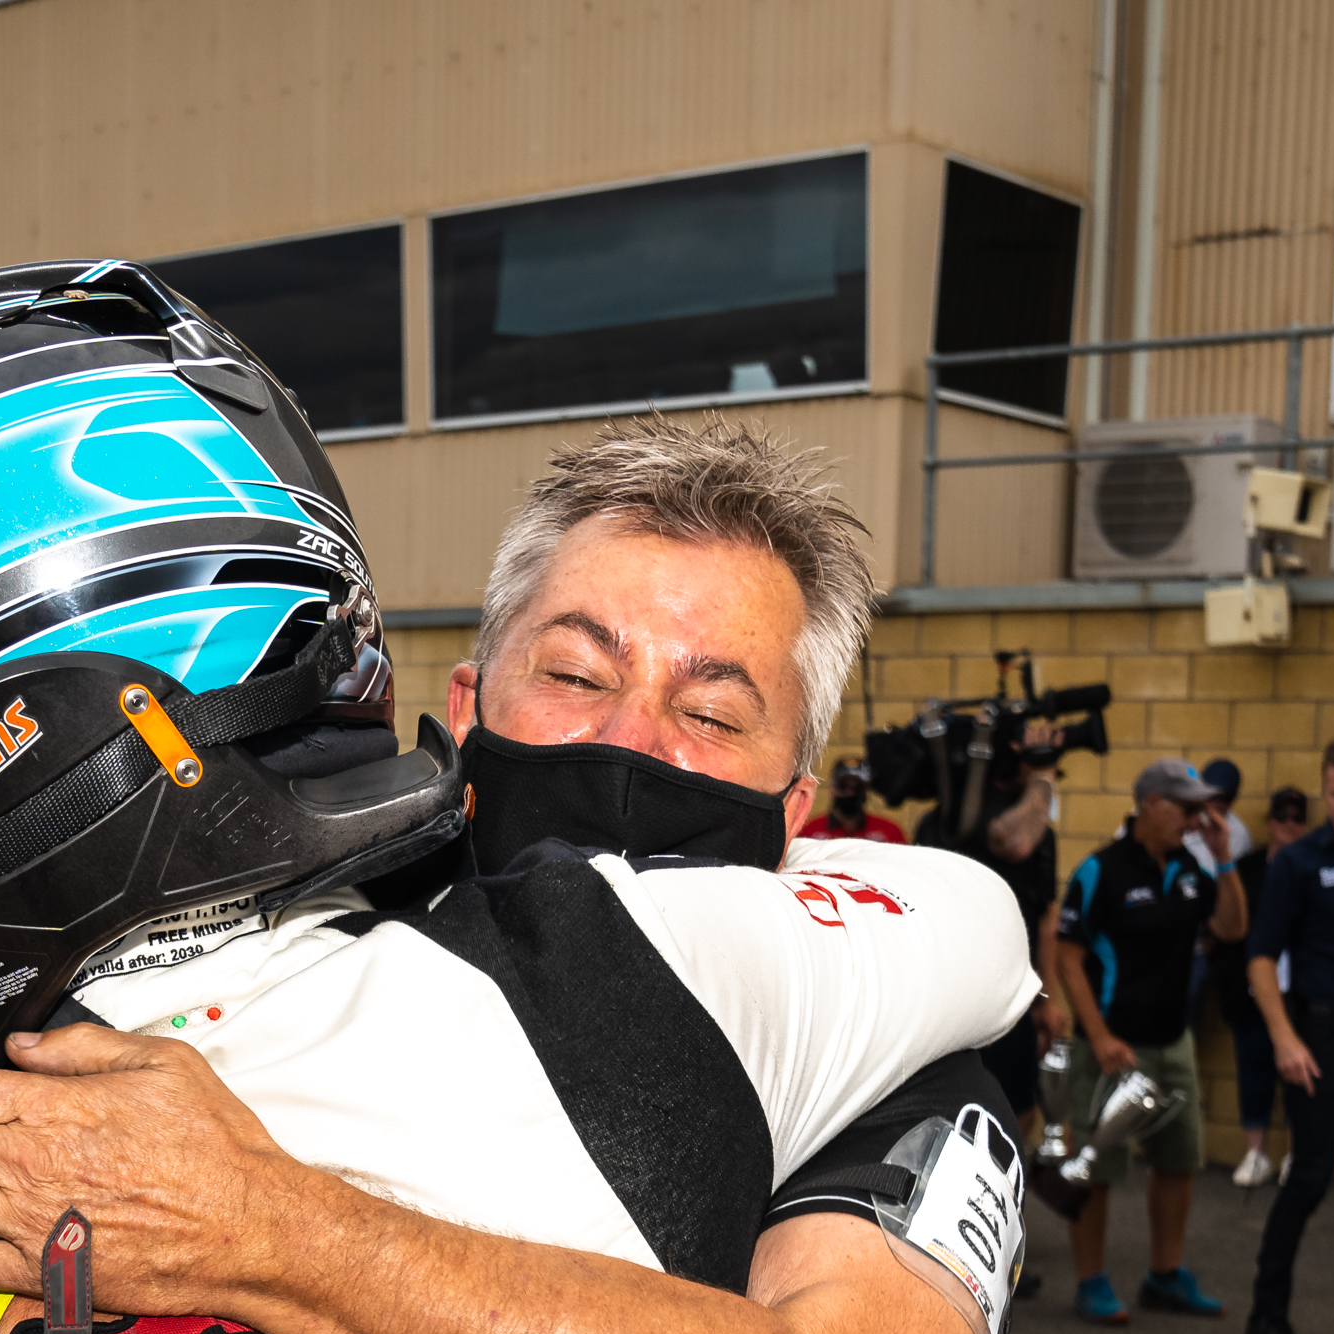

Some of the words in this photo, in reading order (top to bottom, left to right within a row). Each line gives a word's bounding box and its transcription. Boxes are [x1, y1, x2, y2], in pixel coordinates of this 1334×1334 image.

[296, 529, 341, 560] ZAC
[148, 928, 189, 946] FREE
[90, 957, 124, 977] valid
[128, 952, 166, 970] after:
[170, 944, 204, 962] 2030
